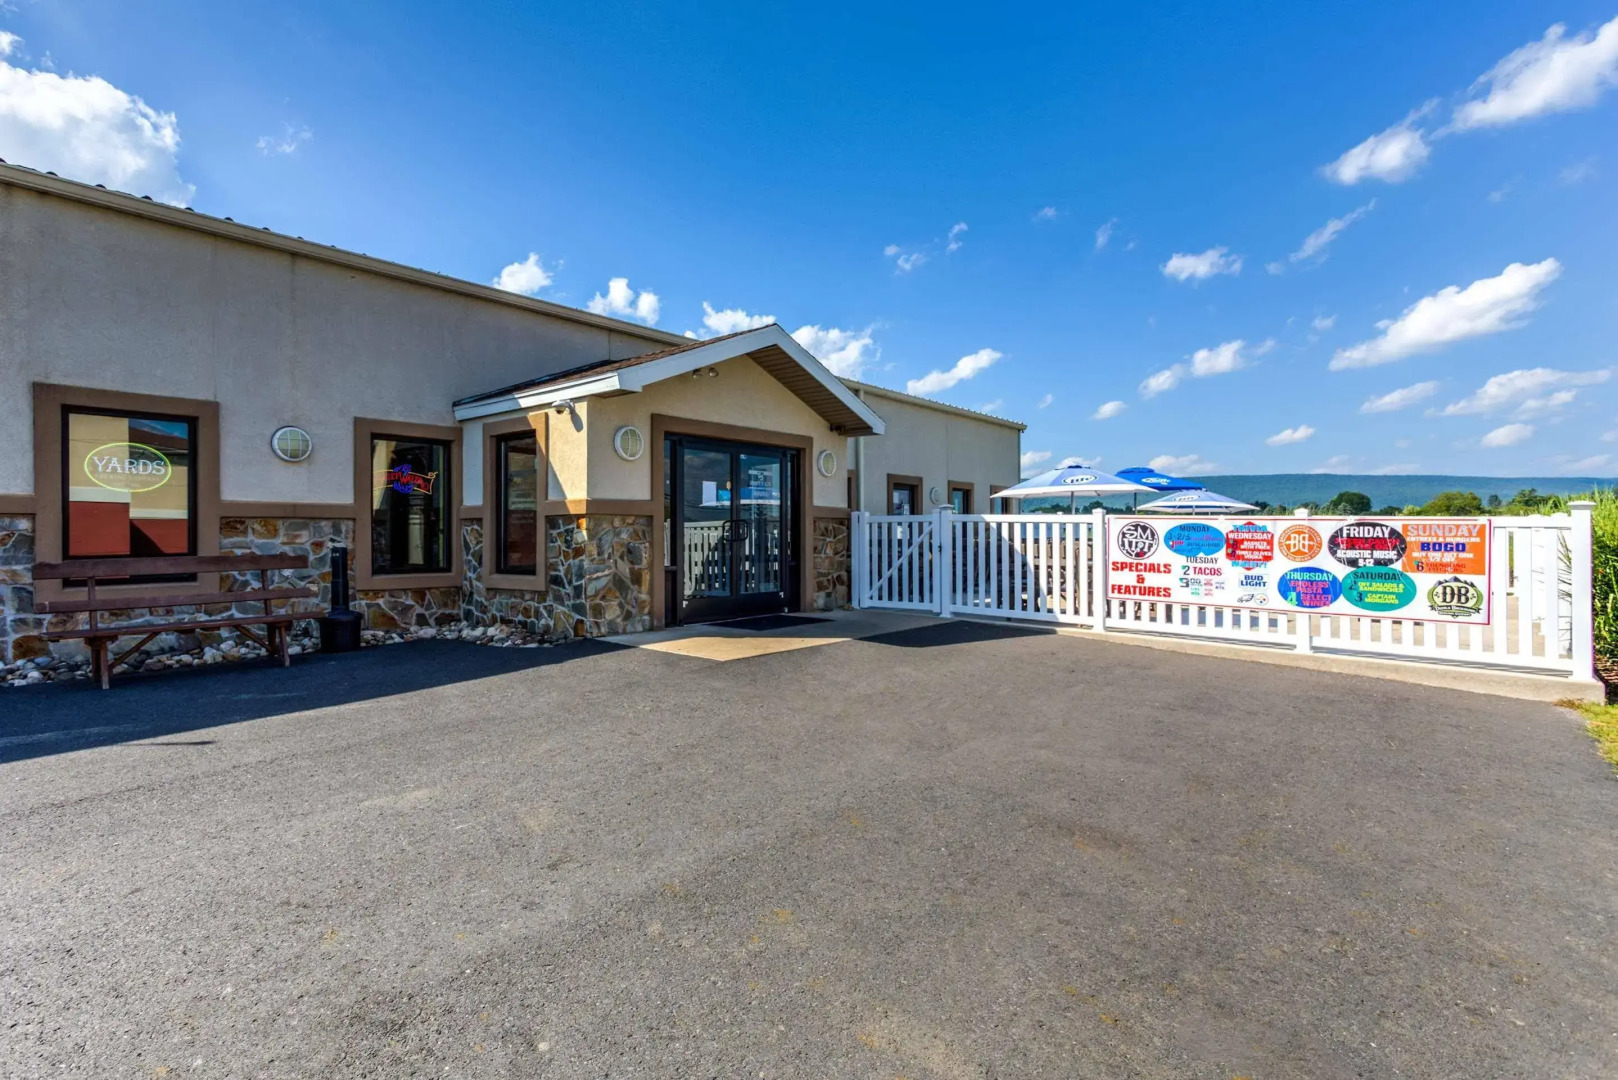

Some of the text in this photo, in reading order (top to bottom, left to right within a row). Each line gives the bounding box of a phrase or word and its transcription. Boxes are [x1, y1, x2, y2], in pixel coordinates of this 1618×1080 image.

[92, 456, 165, 475] YARDS
[1179, 525, 1210, 533] MONDAY
[1342, 526, 1391, 538] FRIDAY
[1407, 524, 1481, 537] SUNDAY
[1228, 532, 1272, 540] WEDNESDAY
[1420, 542, 1467, 552] BOGO
[1336, 550, 1397, 559] ACOUSTIC MUSIC
[1186, 556, 1219, 564] TUESDAY
[1111, 561, 1172, 574] SPECIALS
[1192, 566, 1222, 576] TACOS
[1136, 574, 1145, 584] &
[1287, 571, 1333, 581] THURSDAY
[1353, 571, 1403, 581] SATURDAY
[1290, 580, 1329, 588] ENDLESS
[1111, 584, 1172, 598] FEATURES
[1296, 586, 1323, 594] PASTA
[1441, 585, 1470, 604] DB
[1301, 593, 1332, 601] SELECT
